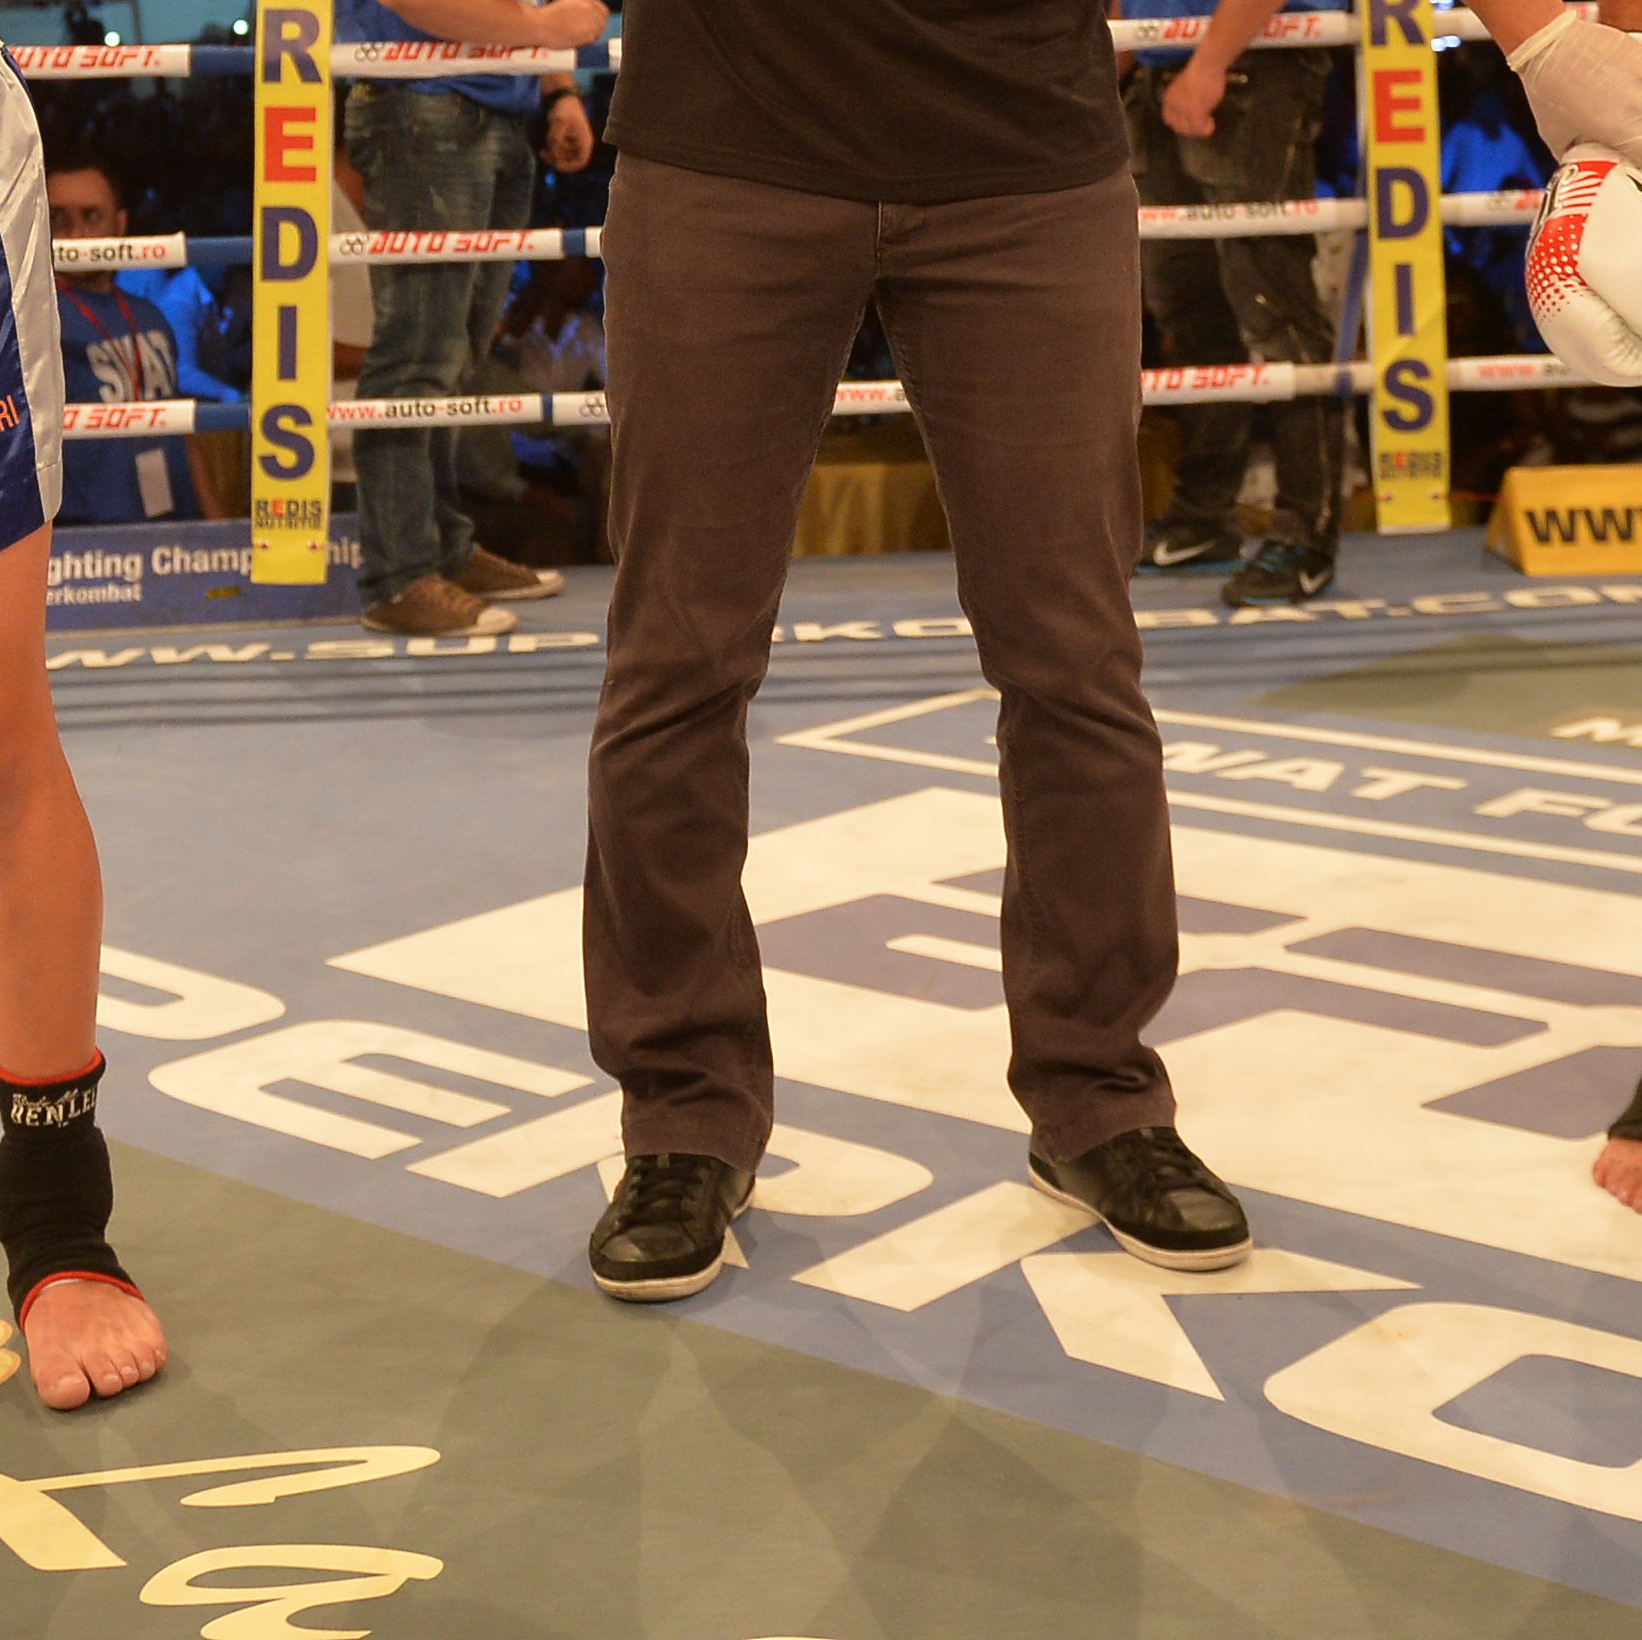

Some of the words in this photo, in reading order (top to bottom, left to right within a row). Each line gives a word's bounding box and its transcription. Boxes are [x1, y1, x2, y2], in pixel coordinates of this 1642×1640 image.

[1263, 17, 1323, 39] OFT
[12, 47, 75, 68] UTO
[53, 244, 166, 261] to-soft.ro
[259, 8, 324, 481] REDIS
[47, 549, 145, 586] ghting
[1160, 738, 1469, 800] WAT
